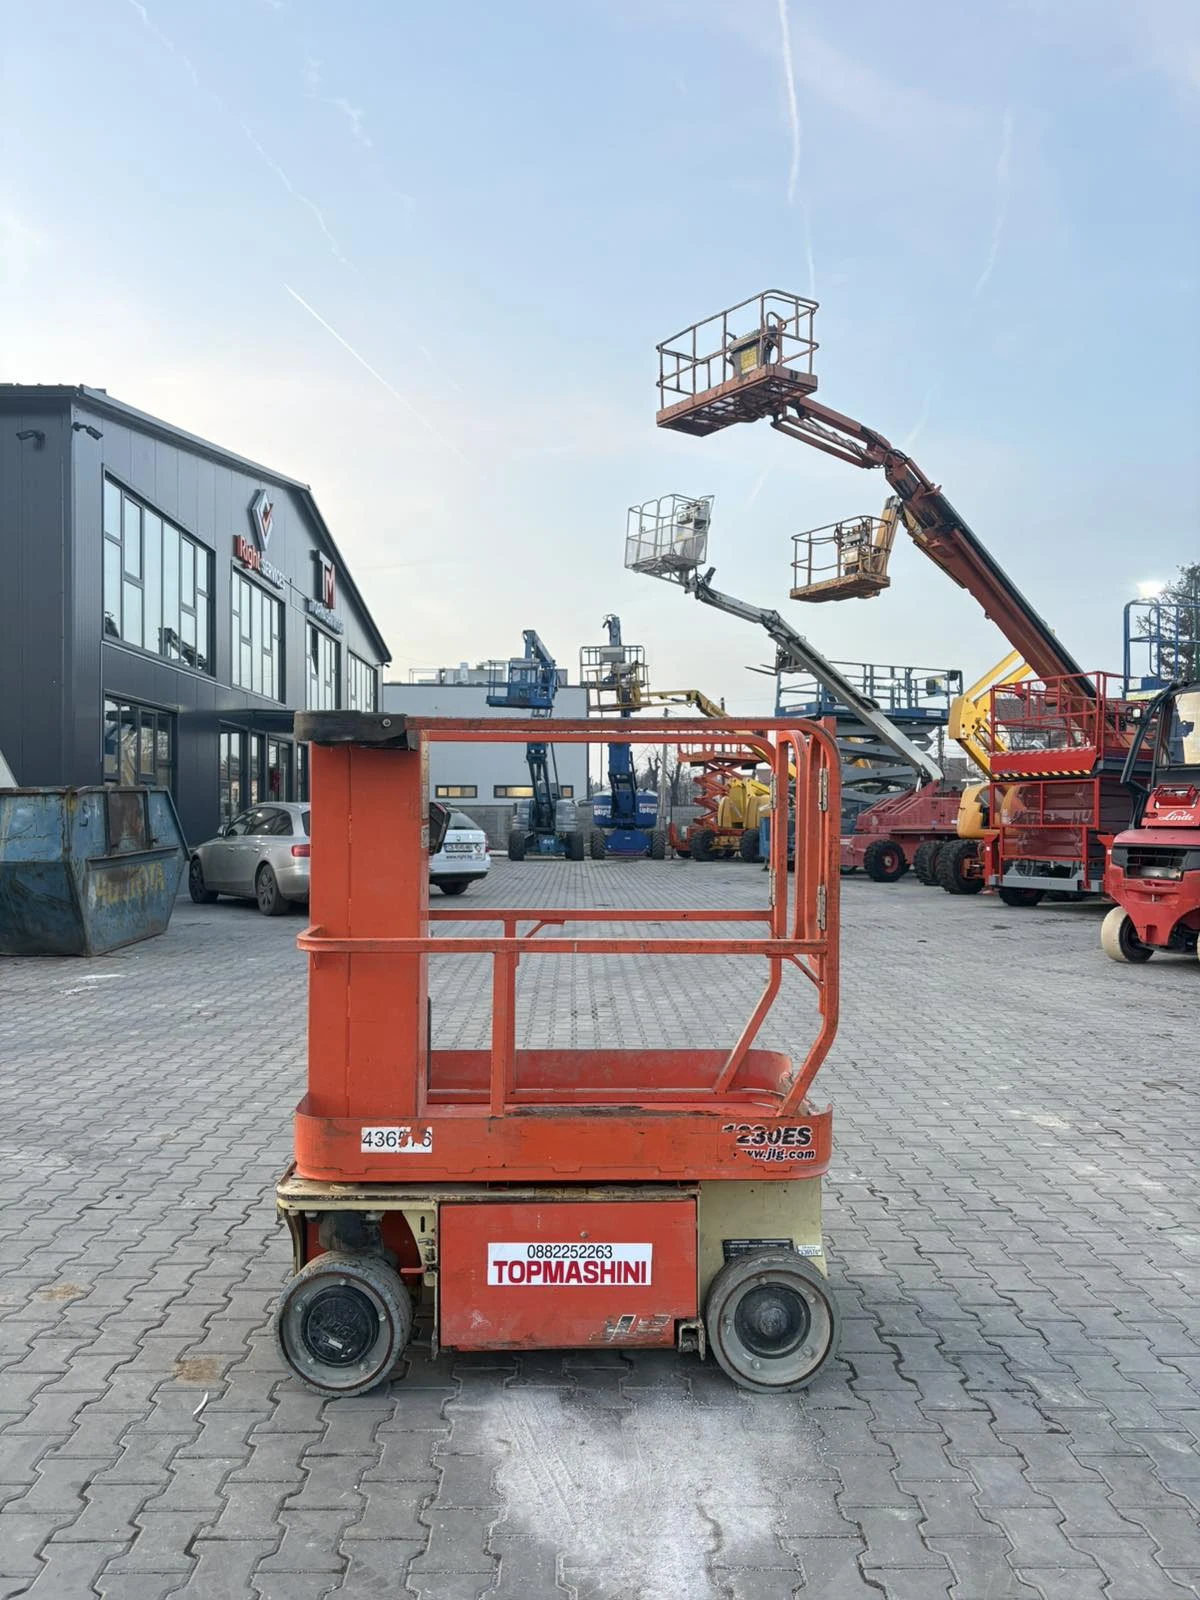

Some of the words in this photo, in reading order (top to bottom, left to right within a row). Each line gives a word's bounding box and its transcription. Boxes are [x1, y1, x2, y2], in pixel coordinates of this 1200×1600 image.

[1158, 809, 1194, 821] Linde
[527, 1244, 613, 1259] 0882252263
[493, 1260, 647, 1284] TOPMASHINI
